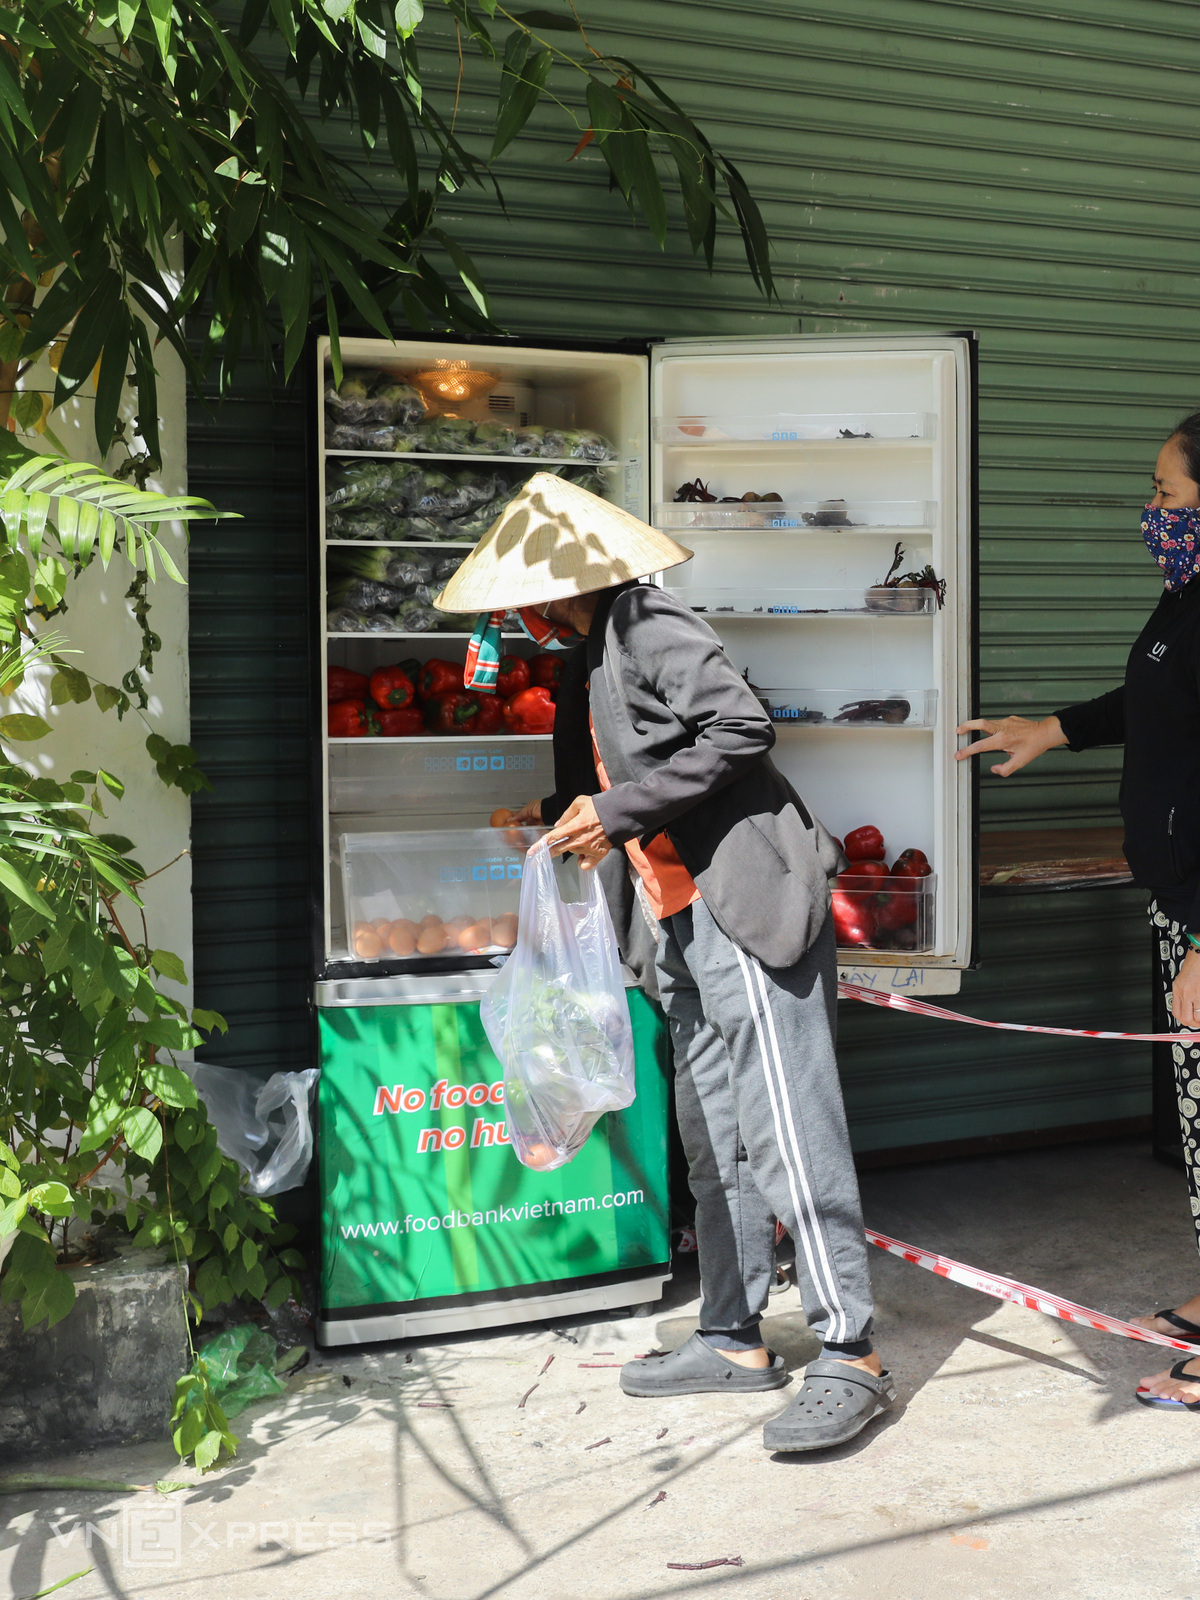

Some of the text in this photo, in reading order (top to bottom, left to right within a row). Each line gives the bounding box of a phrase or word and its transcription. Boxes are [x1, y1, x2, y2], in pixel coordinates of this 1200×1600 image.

[375, 1085, 426, 1114] No
[419, 1127, 466, 1152] no
[341, 1190, 644, 1240] www.foodbankvietnam.com
